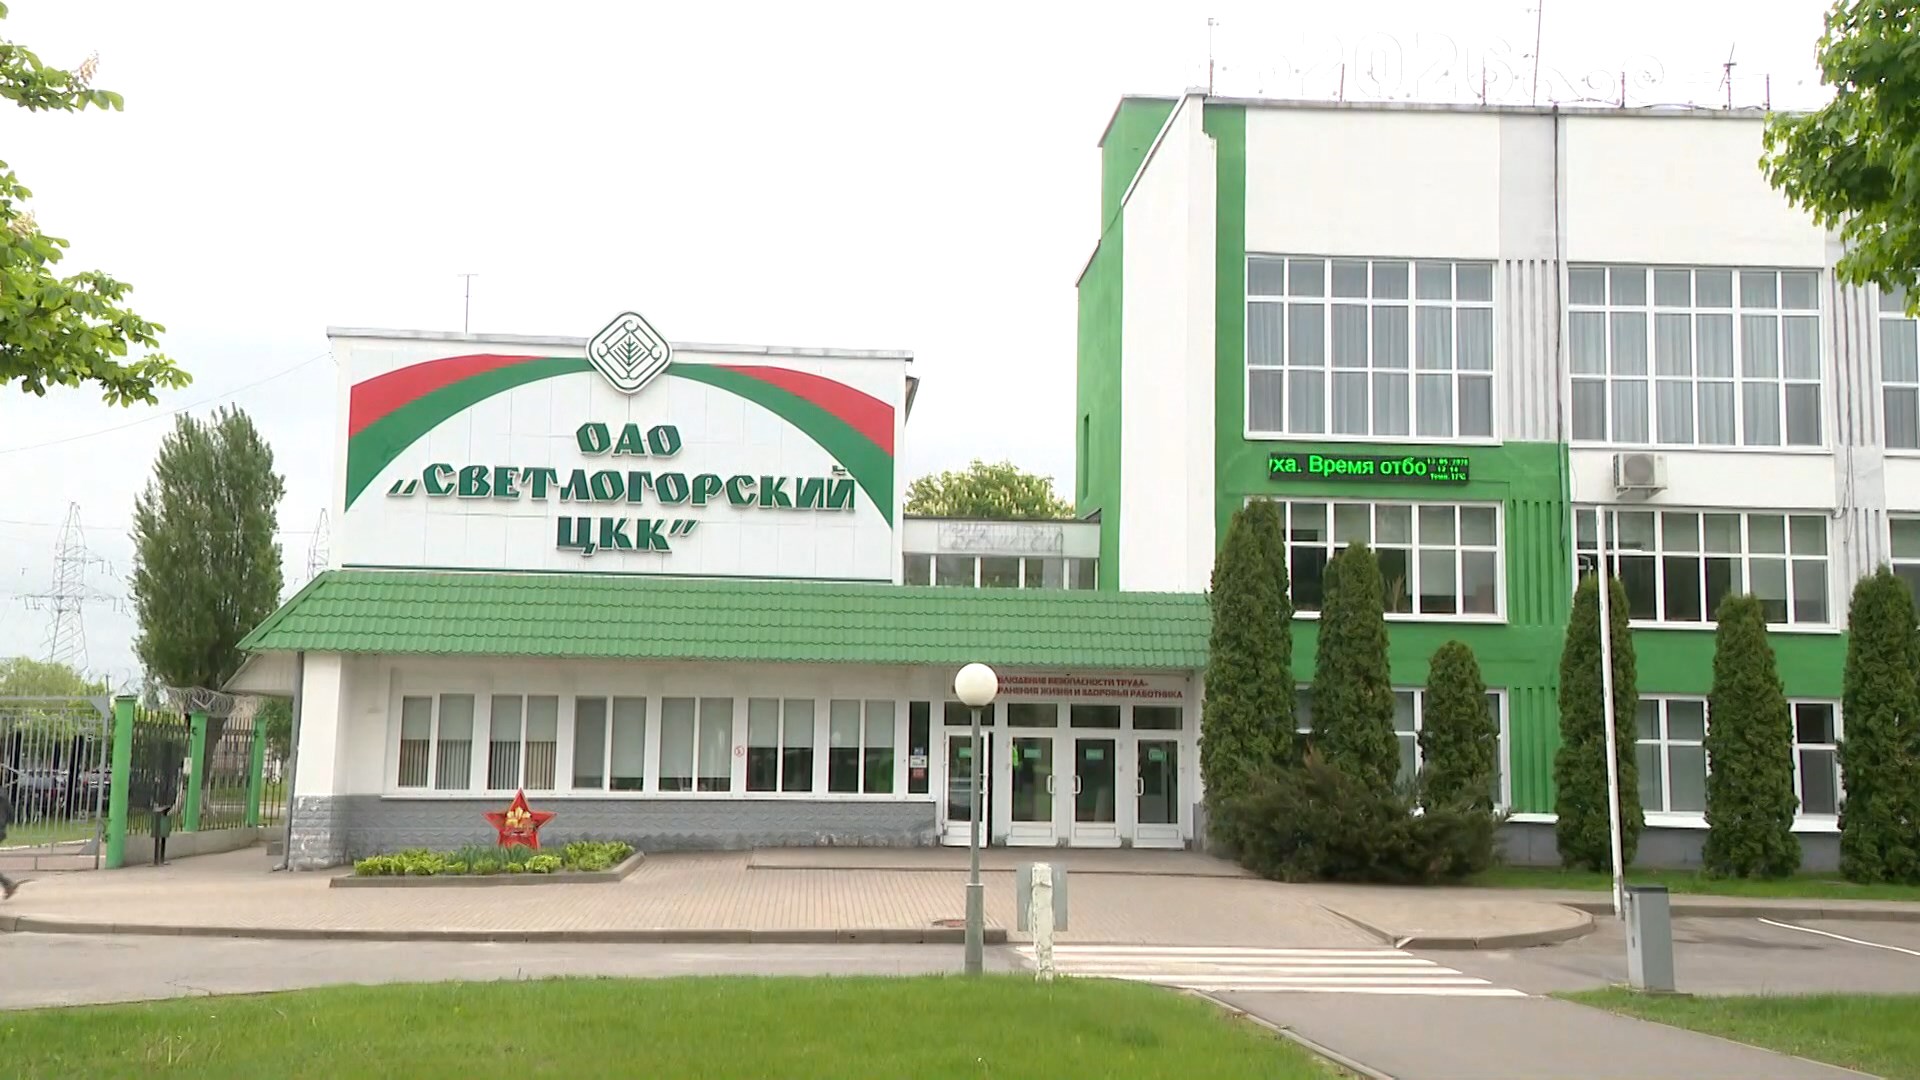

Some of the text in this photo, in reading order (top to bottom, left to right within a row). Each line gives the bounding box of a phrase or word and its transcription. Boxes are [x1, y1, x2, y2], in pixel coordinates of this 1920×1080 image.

[576, 422, 683, 458] ОАО
[1309, 455, 1374, 477] Время
[1380, 457, 1427, 475] отбо
[997, 676, 1047, 685] БЛЮДЕНИЕ
[1048, 677, 1115, 687] БЕЗОПАСНОСТИ
[997, 685, 1183, 698] РАНЕНИЯ ЖИЗНИ И ЗДОРОВЬЯ РАБОТНИКА
